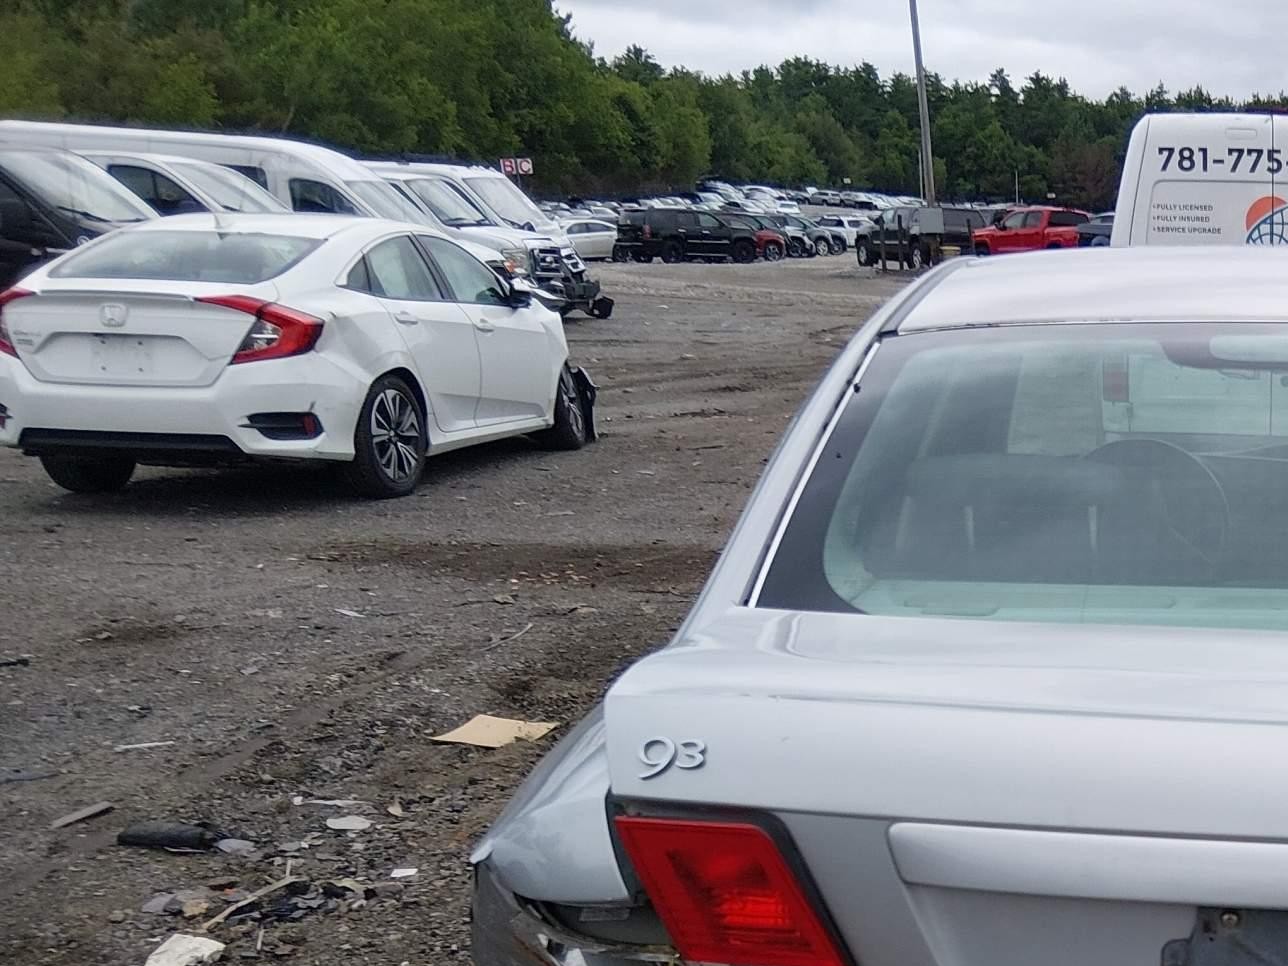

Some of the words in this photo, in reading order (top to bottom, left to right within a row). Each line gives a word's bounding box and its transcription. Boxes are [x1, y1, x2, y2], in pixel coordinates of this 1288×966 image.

[503, 159, 514, 173] B
[520, 159, 531, 173] C
[1156, 203, 1177, 211] FULLY
[1178, 204, 1214, 212] LICENSED
[1178, 215, 1210, 223] INSURED
[1156, 226, 1187, 234] SERVICE
[1188, 227, 1222, 235] UPGRADE
